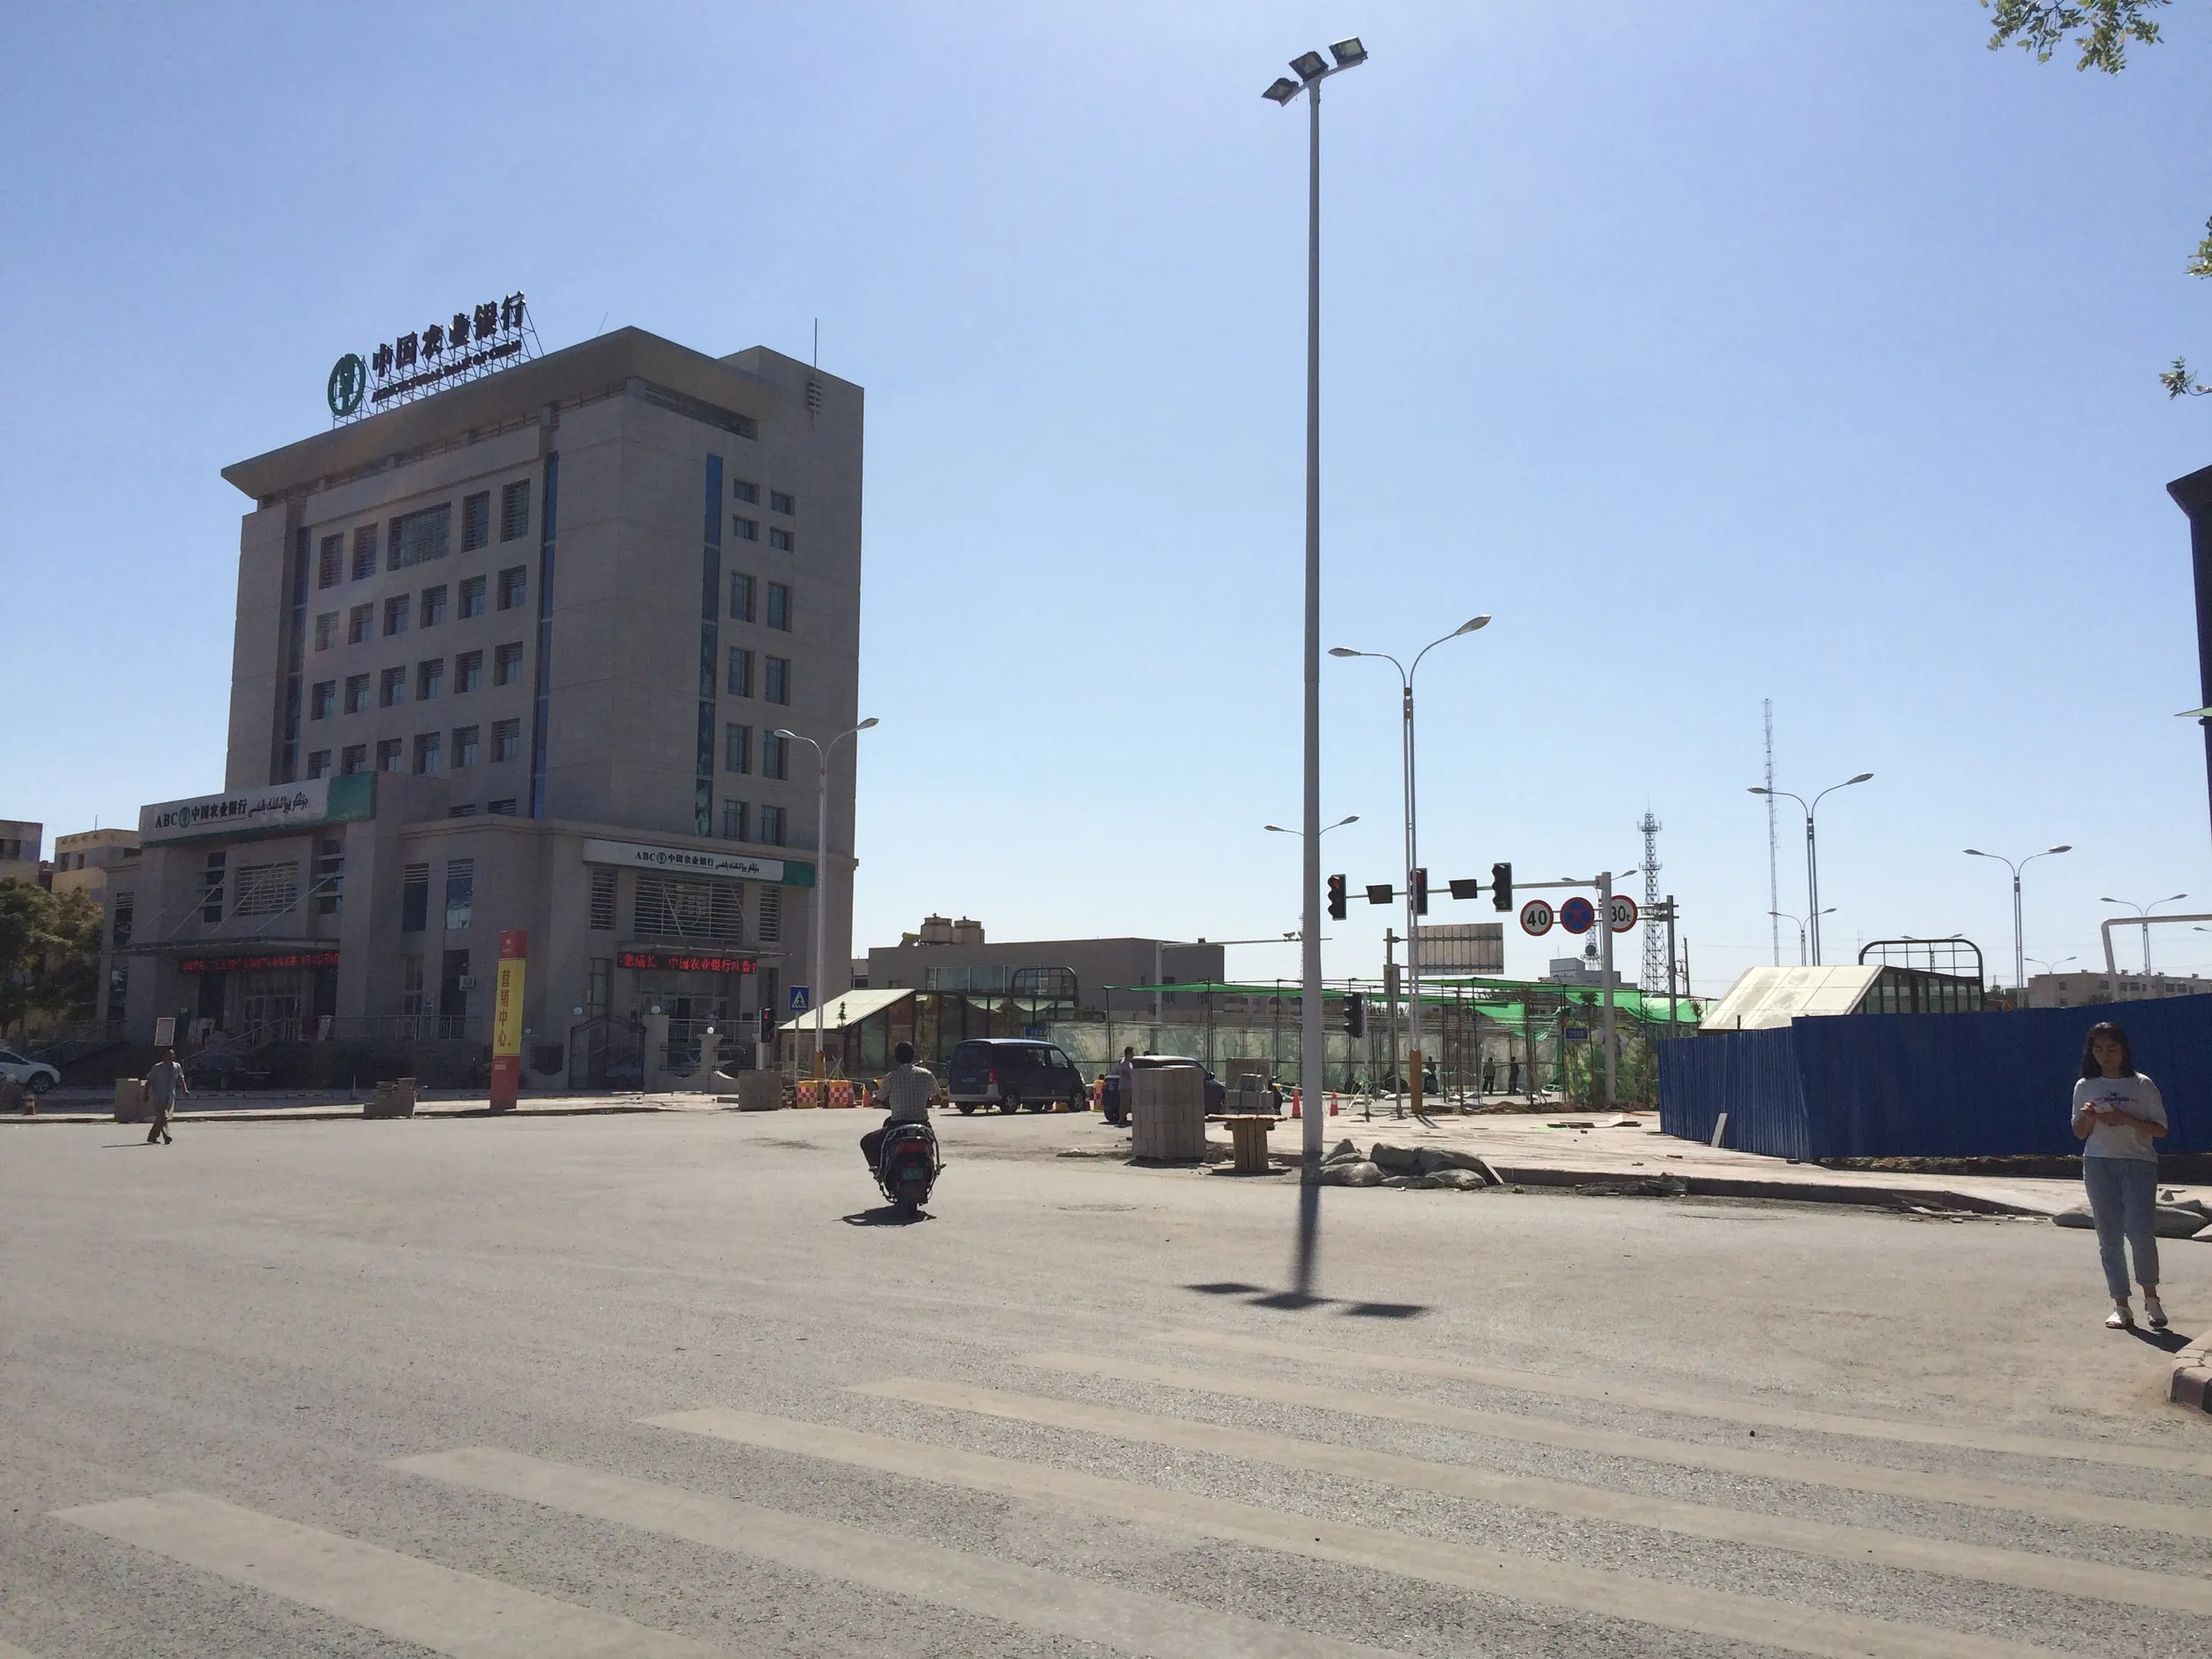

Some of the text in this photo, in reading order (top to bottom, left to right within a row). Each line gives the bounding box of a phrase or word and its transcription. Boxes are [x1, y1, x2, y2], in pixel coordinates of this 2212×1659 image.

[373, 290, 526, 378] 中国农业银行
[155, 798, 248, 828] ABC 中国农业银行
[635, 851, 715, 866] ABC 中国农业银行
[1527, 910, 1548, 927] 40
